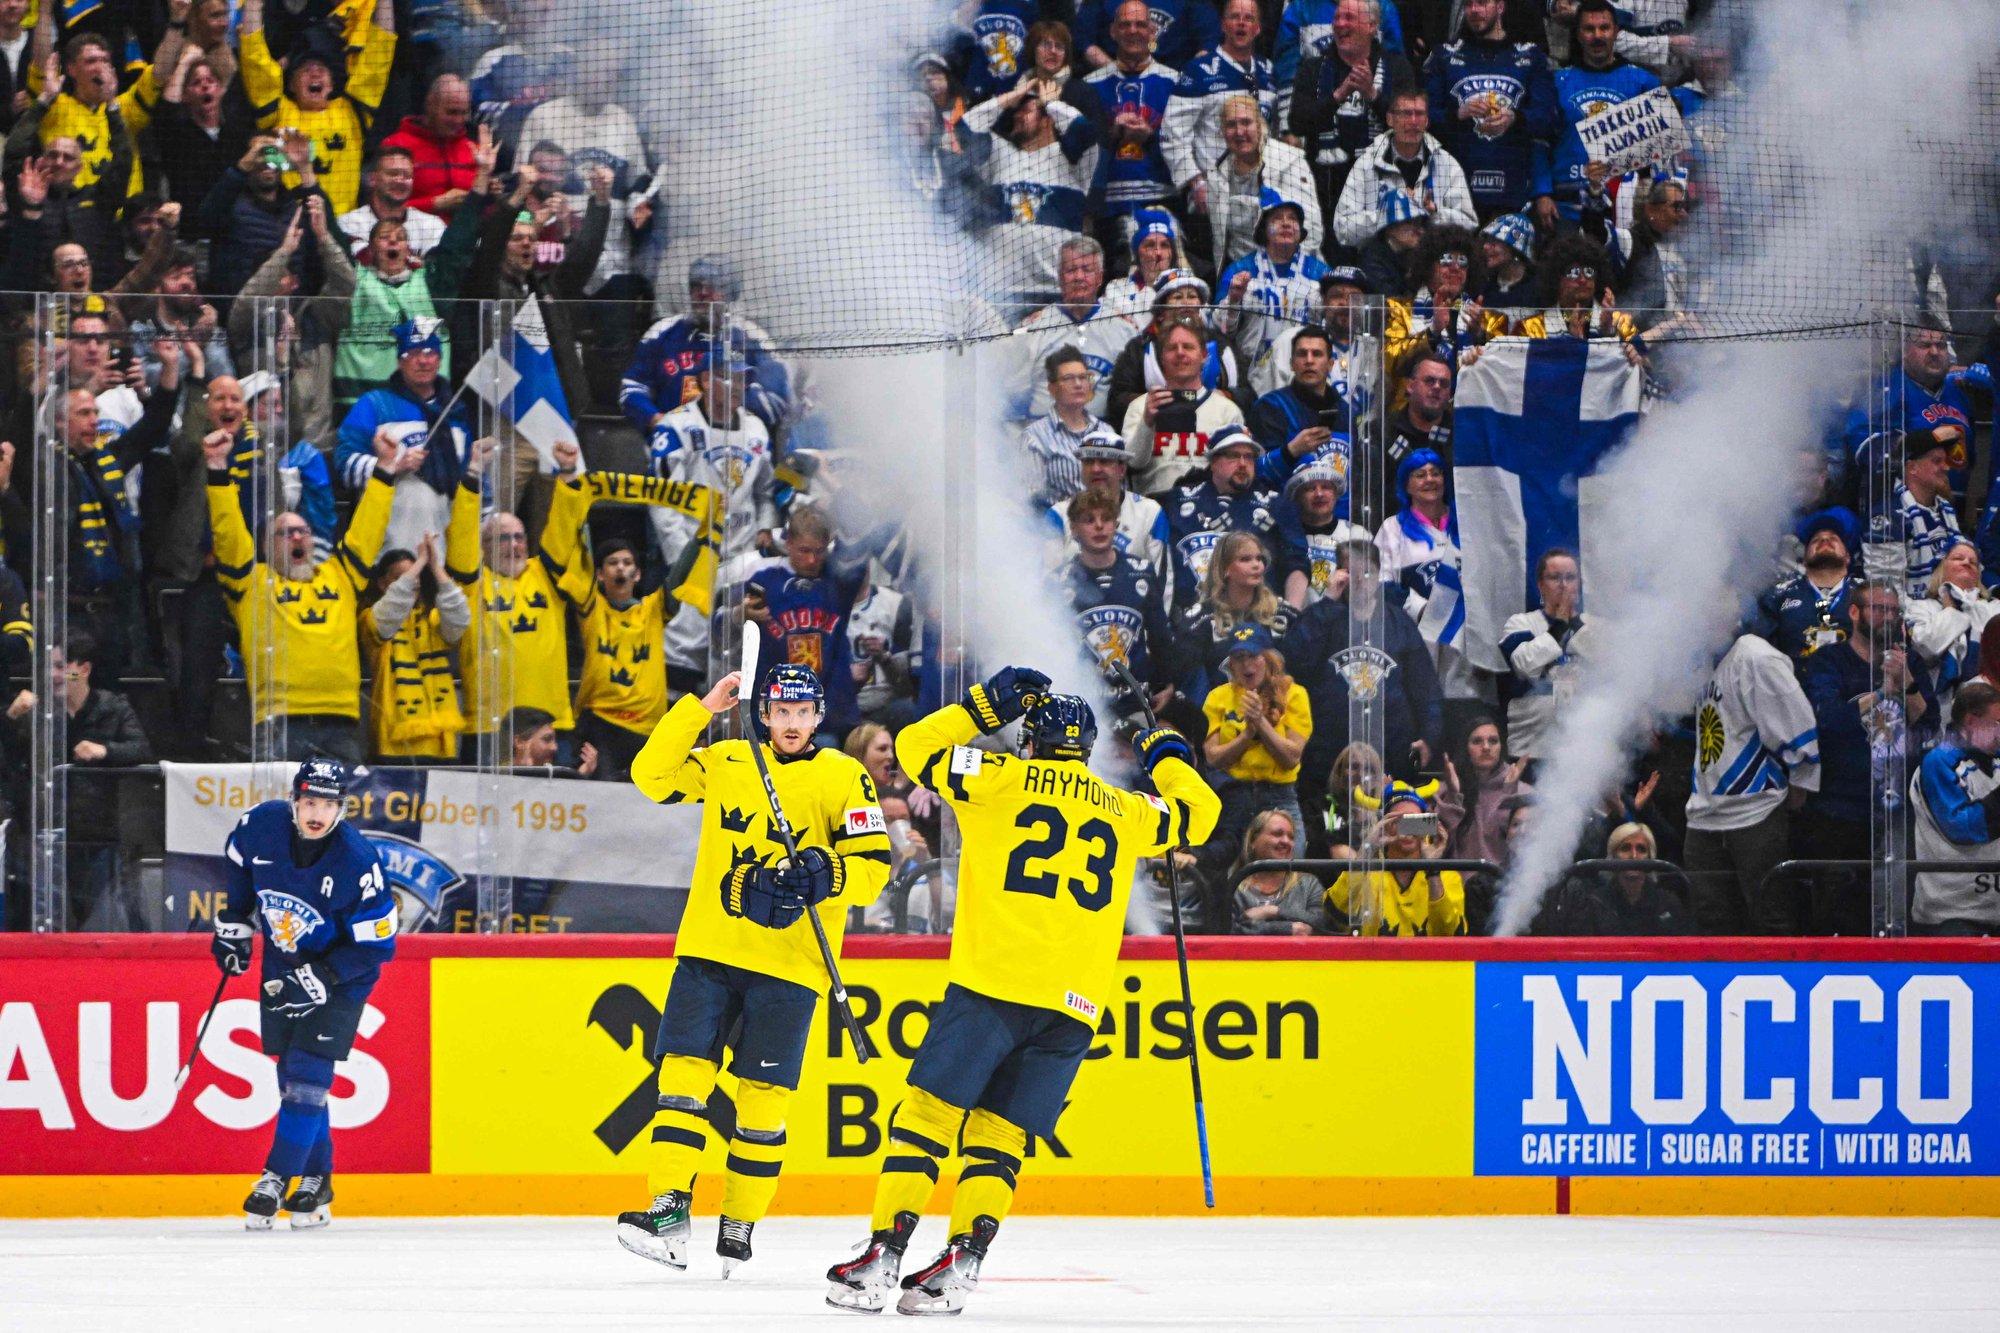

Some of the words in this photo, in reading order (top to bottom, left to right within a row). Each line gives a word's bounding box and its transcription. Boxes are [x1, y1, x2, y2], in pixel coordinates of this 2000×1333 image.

[1463, 78, 1516, 95] SUOMI
[584, 470, 707, 512] SVERIGE
[1066, 725, 1080, 737] 23
[1023, 765, 1123, 818] RAYMOND
[384, 790, 499, 827] Globen
[512, 799, 589, 833] 1995
[1003, 802, 1119, 912] 23
[320, 876, 334, 899] A
[267, 894, 310, 919] SUOMI
[1074, 995, 1096, 1016] IIHF
[1522, 974, 1974, 1126] NOCCO
[1521, 1132, 1637, 1165] CAFFEINE
[1661, 1132, 1744, 1165] SUGAR
[1751, 1132, 1810, 1165] FREE
[1834, 1132, 1899, 1165] WITH
[1906, 1132, 1973, 1165] BCAA
